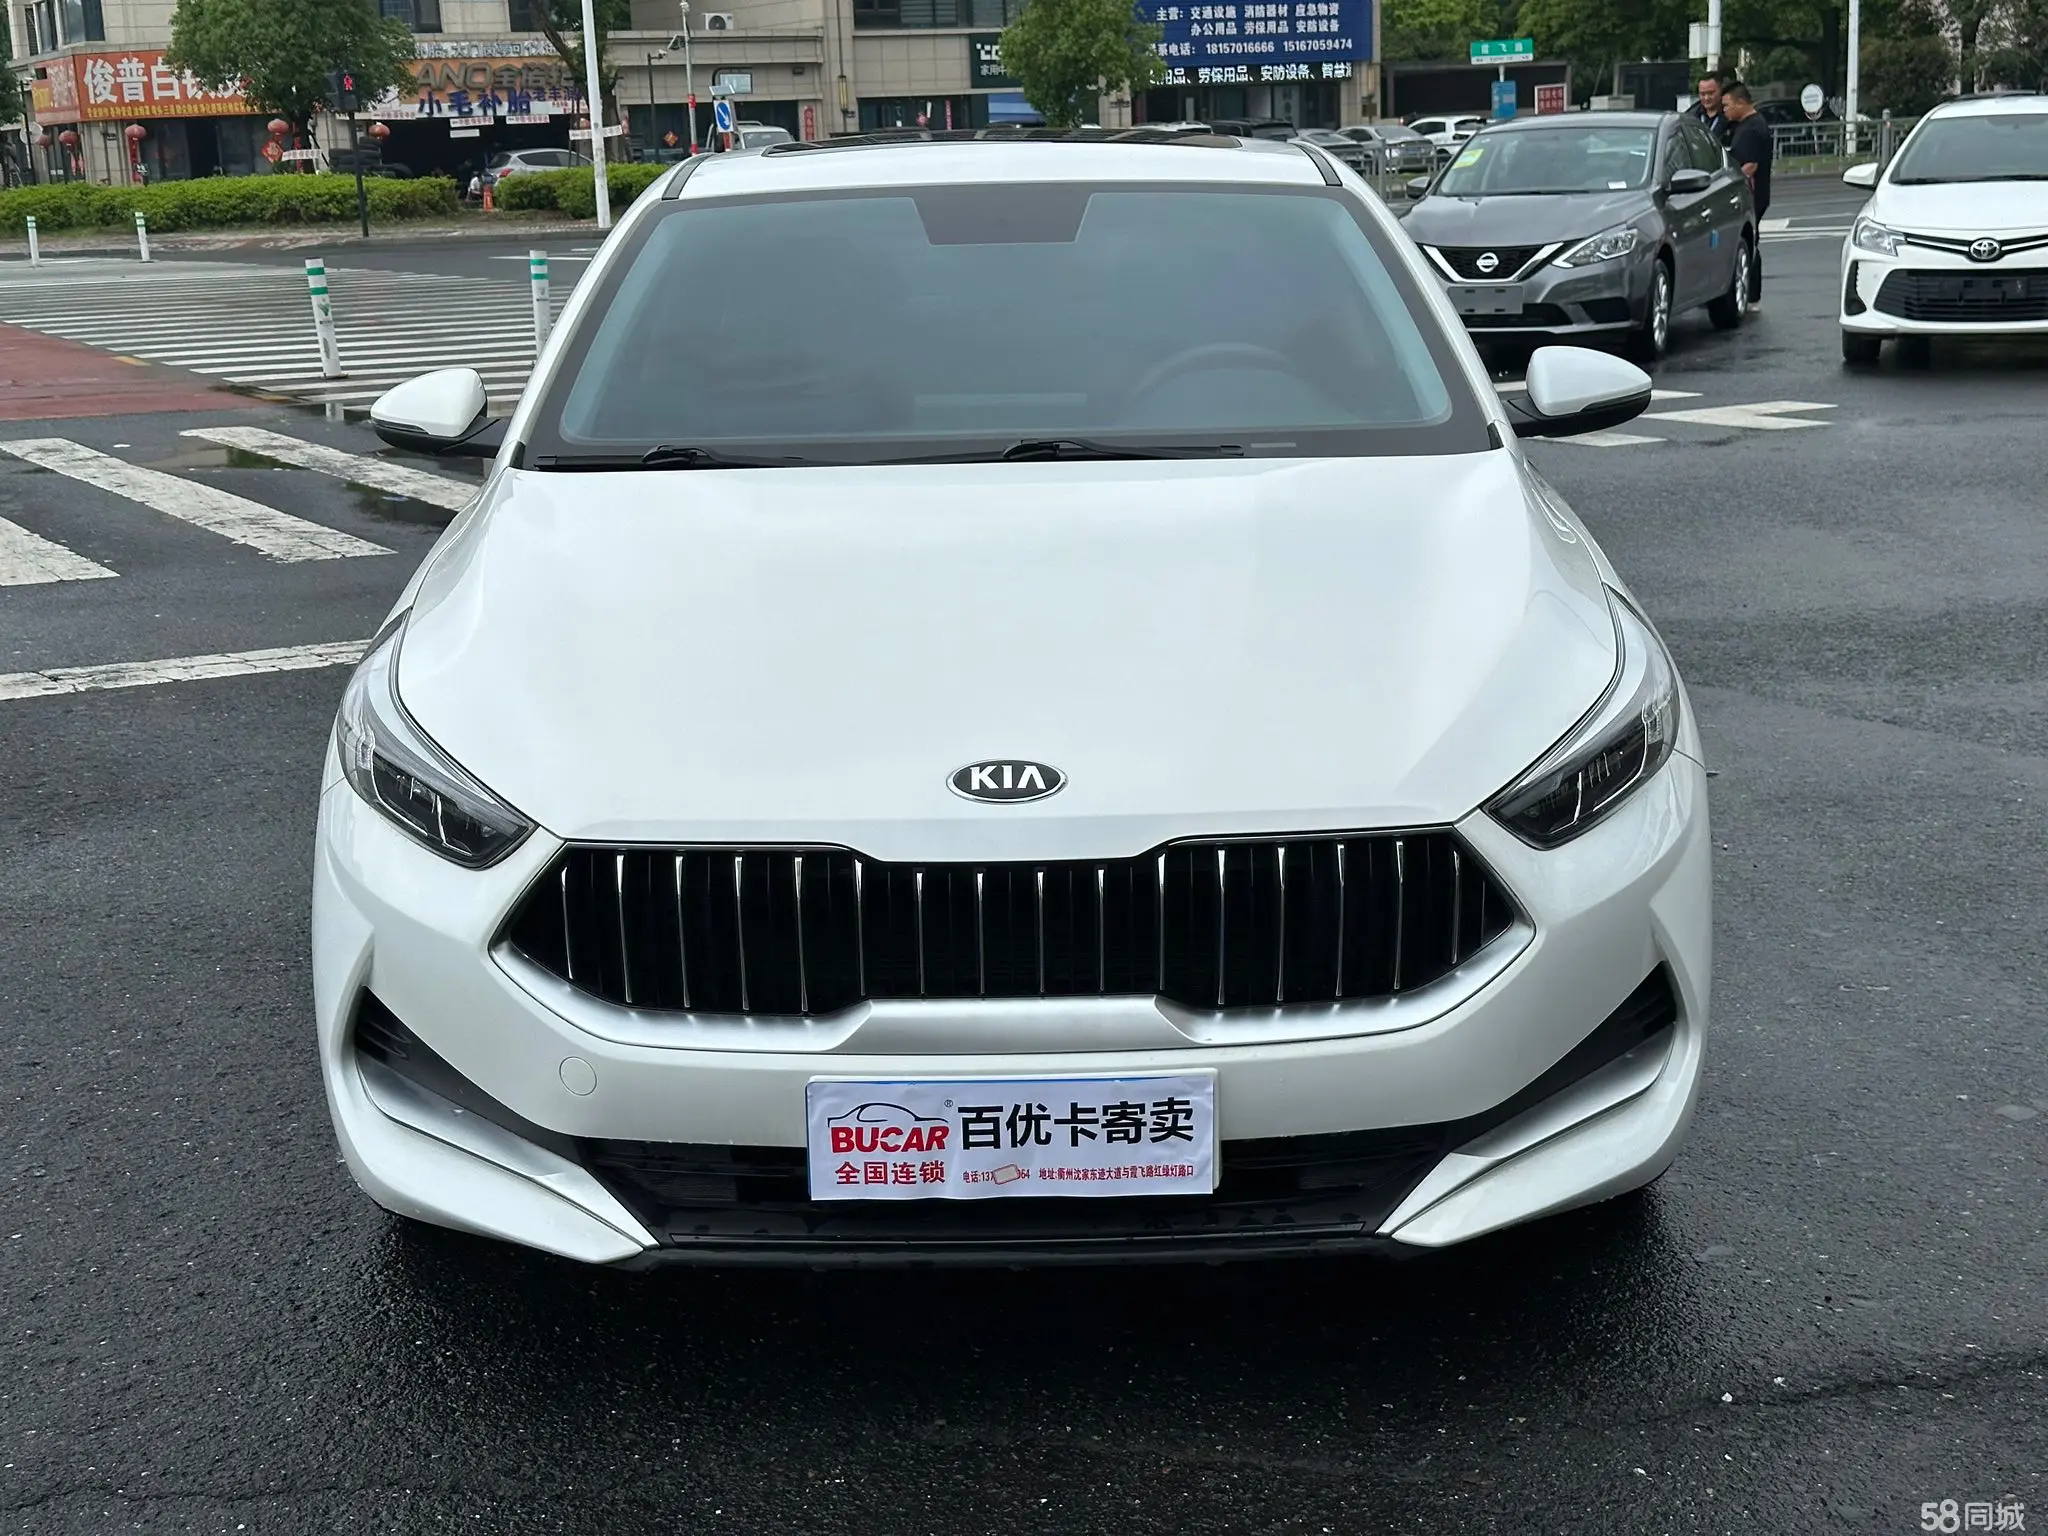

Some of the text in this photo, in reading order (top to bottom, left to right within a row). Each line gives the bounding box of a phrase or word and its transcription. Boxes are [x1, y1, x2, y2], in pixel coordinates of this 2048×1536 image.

[1190, 5, 1237, 20] 交通设施
[1244, 4, 1288, 18] 消防器材
[1295, 2, 1339, 17] 应急物资
[1190, 19, 1340, 36] 办公用品 劳保用品 安防设备
[1205, 41, 1275, 54] 18157016666
[1283, 38, 1353, 52] 15167059474
[969, 765, 1046, 790] KIA
[958, 1098, 1195, 1150] 百优卡寄卖
[831, 1126, 950, 1153] BUCAR
[835, 1161, 946, 1185] 全国连锁
